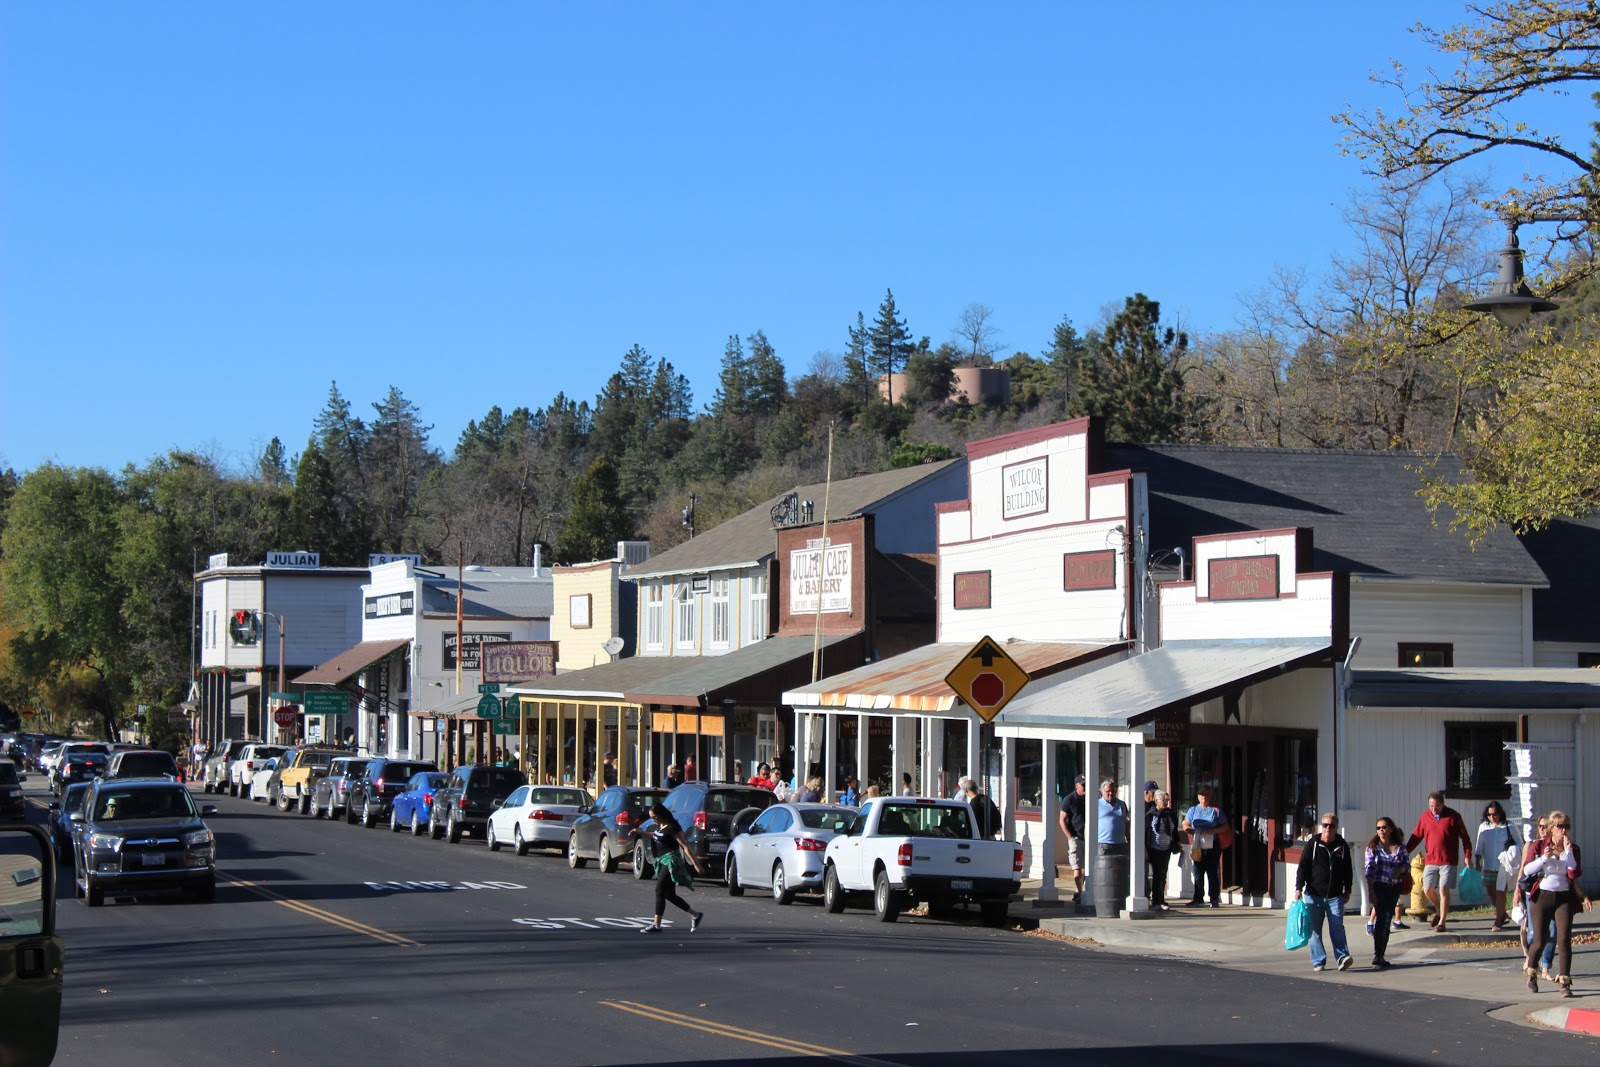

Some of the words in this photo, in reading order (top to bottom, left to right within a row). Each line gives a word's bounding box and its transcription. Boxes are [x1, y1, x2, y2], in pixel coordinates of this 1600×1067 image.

[1009, 468, 1043, 488] WILCOX
[1006, 488, 1045, 511] BUILDING
[271, 554, 317, 566] JULIAN
[826, 550, 848, 577] CAFE
[1211, 562, 1238, 590] JULIAN
[1241, 560, 1275, 583] TRADING
[799, 581, 804, 595] &
[1226, 580, 1260, 595] COMPANY
[445, 635, 480, 647] MIER'S
[486, 644, 522, 655] MOUNTAIN
[526, 643, 553, 654] SPIRITS
[486, 655, 553, 675] LIQUOR
[481, 703, 499, 715] 78
[275, 713, 295, 721] STOP
[363, 881, 527, 891] AHEAD
[511, 916, 673, 929] STOP
